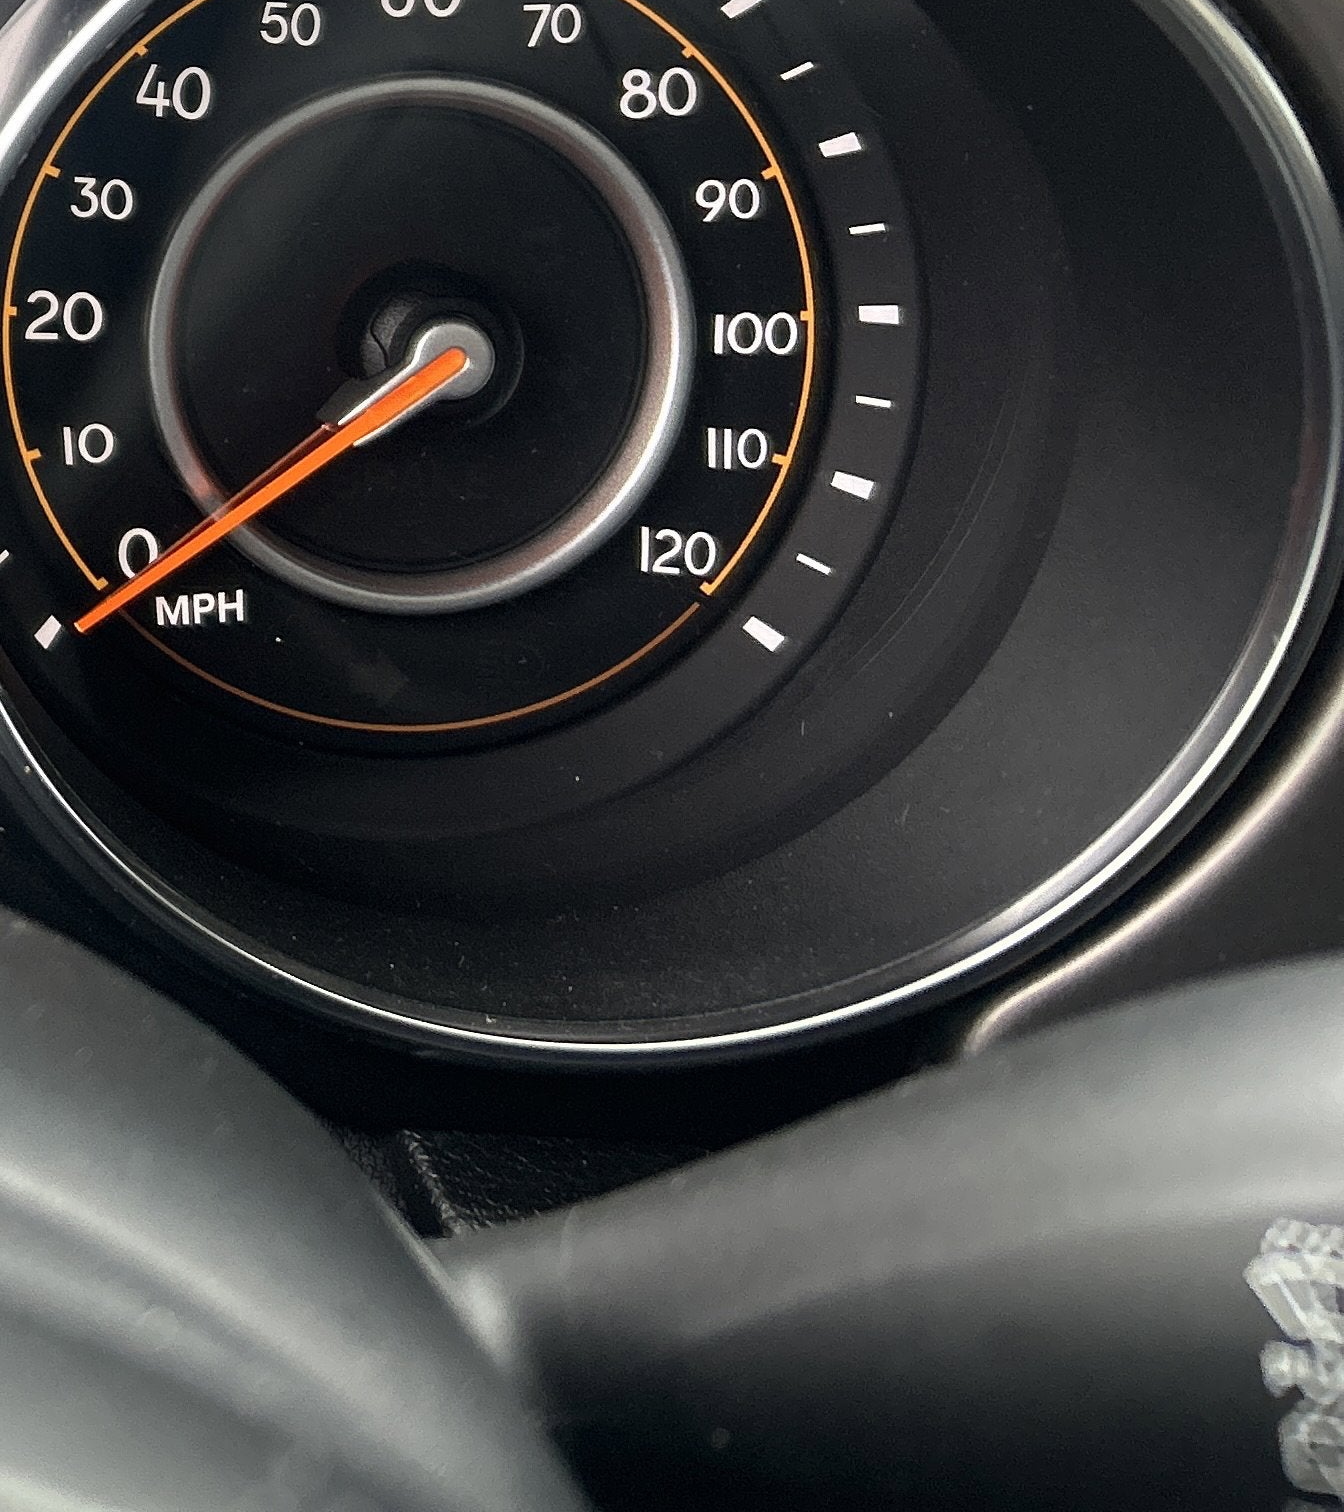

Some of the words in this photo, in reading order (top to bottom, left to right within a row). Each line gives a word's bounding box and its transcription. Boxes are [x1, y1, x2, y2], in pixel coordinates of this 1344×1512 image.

[259, 1, 321, 47] 50
[523, 3, 582, 48] 70
[136, 63, 211, 120] 40
[619, 67, 697, 119] 80
[70, 176, 134, 220] 30
[695, 179, 760, 223] 90
[24, 289, 103, 342] 20
[713, 311, 798, 355] 100
[63, 423, 114, 466] 10
[707, 427, 768, 470] 110
[118, 527, 161, 582] 0
[640, 525, 717, 576] 120
[155, 588, 244, 626] MPH
